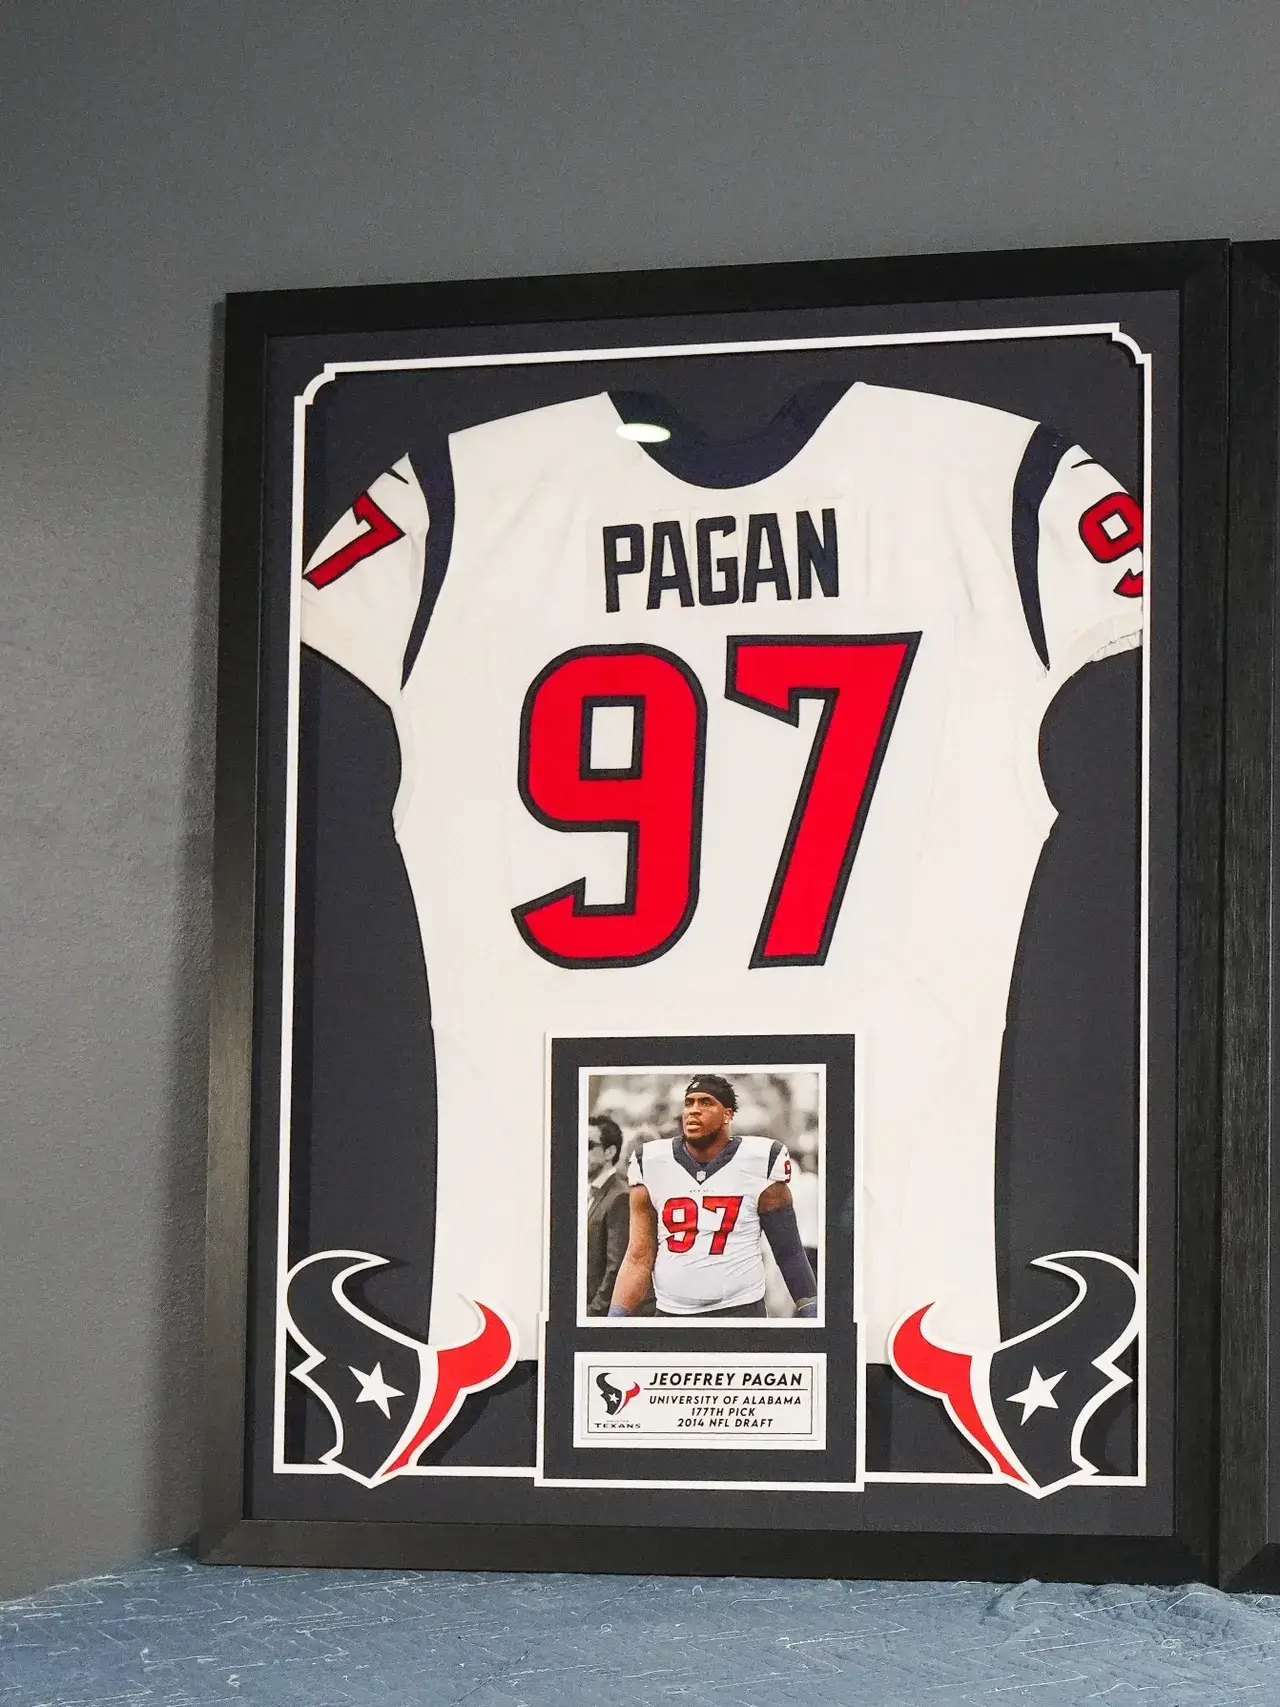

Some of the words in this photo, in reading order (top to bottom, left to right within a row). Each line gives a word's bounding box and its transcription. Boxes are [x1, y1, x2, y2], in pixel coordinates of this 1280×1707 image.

[302, 489, 406, 590] 7
[1078, 491, 1144, 599] 9
[602, 508, 840, 613] PAGAN
[511, 630, 923, 970] 97
[662, 1196, 744, 1255] 97
[649, 1372, 736, 1387] JEOFFREY
[742, 1372, 803, 1387] PAGAN
[649, 1395, 718, 1405] UNIVERSITY
[723, 1395, 738, 1405] OF
[742, 1395, 802, 1406] ALABAMA
[691, 1407, 724, 1417] 177TH
[728, 1407, 756, 1417] PICK
[594, 1422, 642, 1430] TEXANS
[677, 1418, 705, 1428] 2014
[709, 1418, 731, 1428] NFL
[735, 1418, 774, 1428] DRAFT
